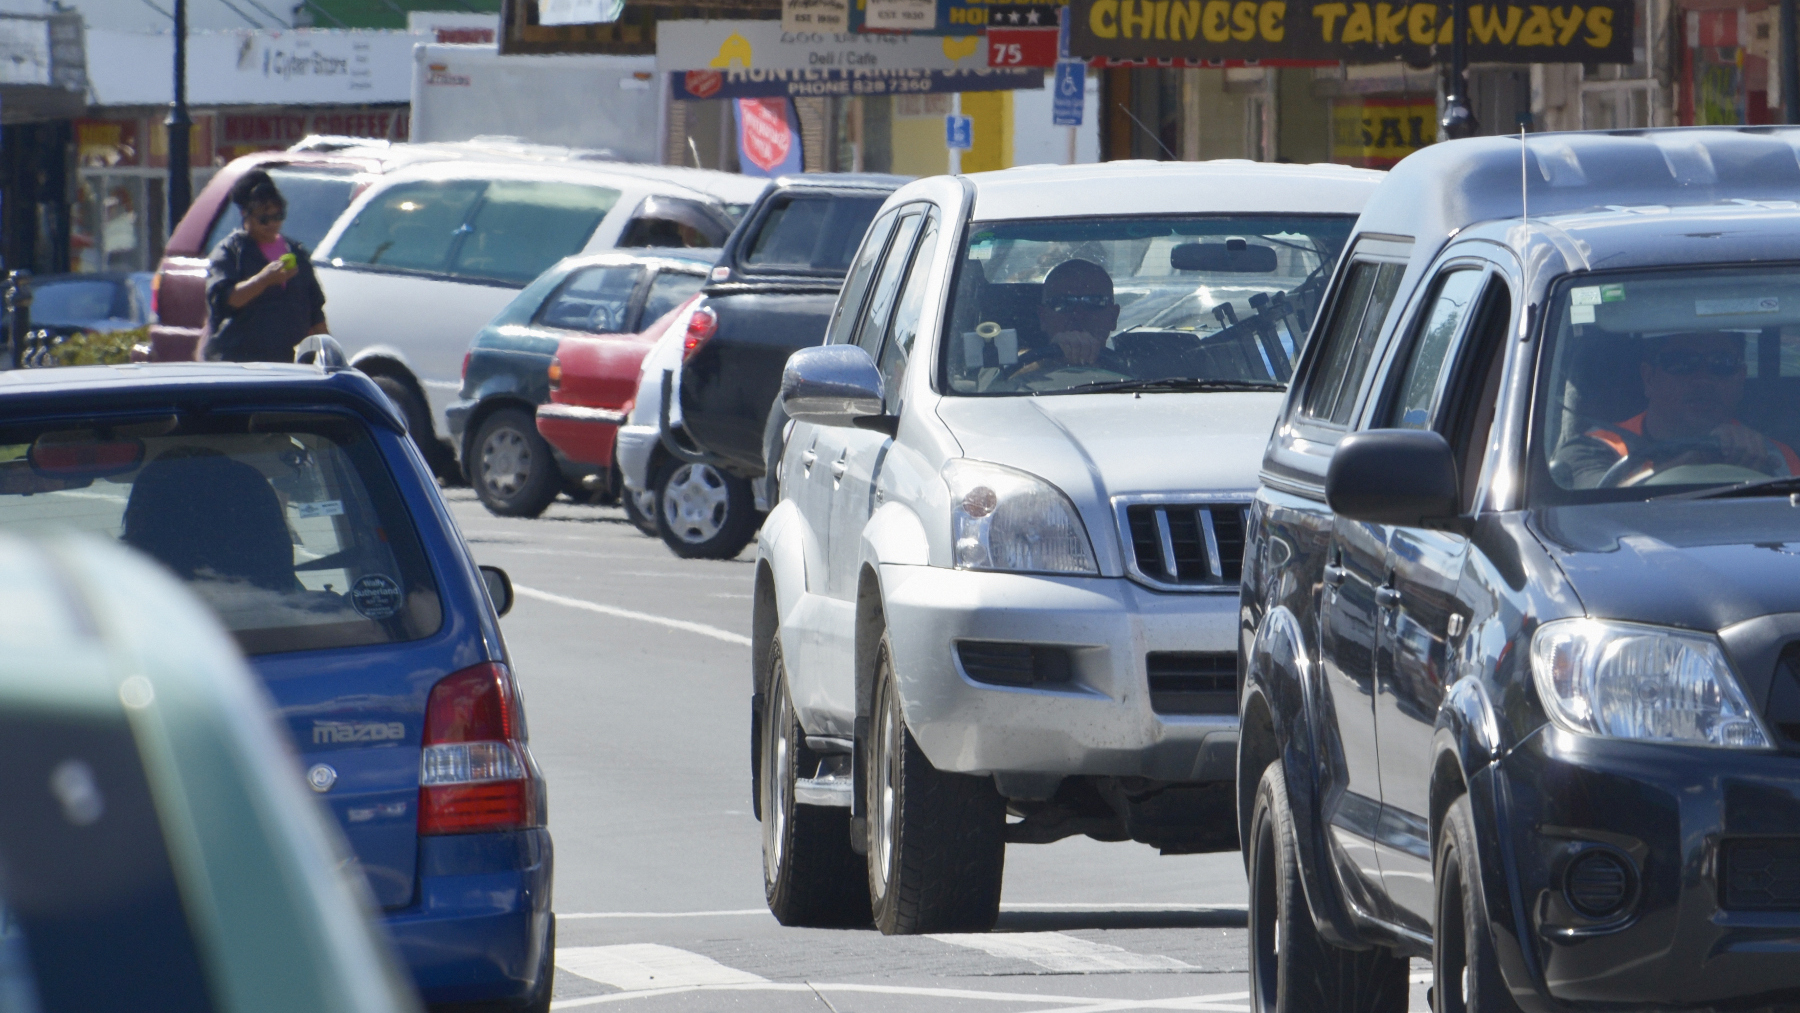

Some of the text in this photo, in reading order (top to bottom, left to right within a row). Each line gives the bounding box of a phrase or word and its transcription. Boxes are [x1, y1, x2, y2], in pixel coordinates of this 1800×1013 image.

[950, 7, 990, 25] HO
[808, 50, 835, 65] Deli
[846, 50, 878, 65] Cafe
[993, 42, 1023, 64] 75
[788, 79, 850, 94] PHONE
[889, 77, 932, 91] 7360
[353, 588, 399, 597] Sutherland
